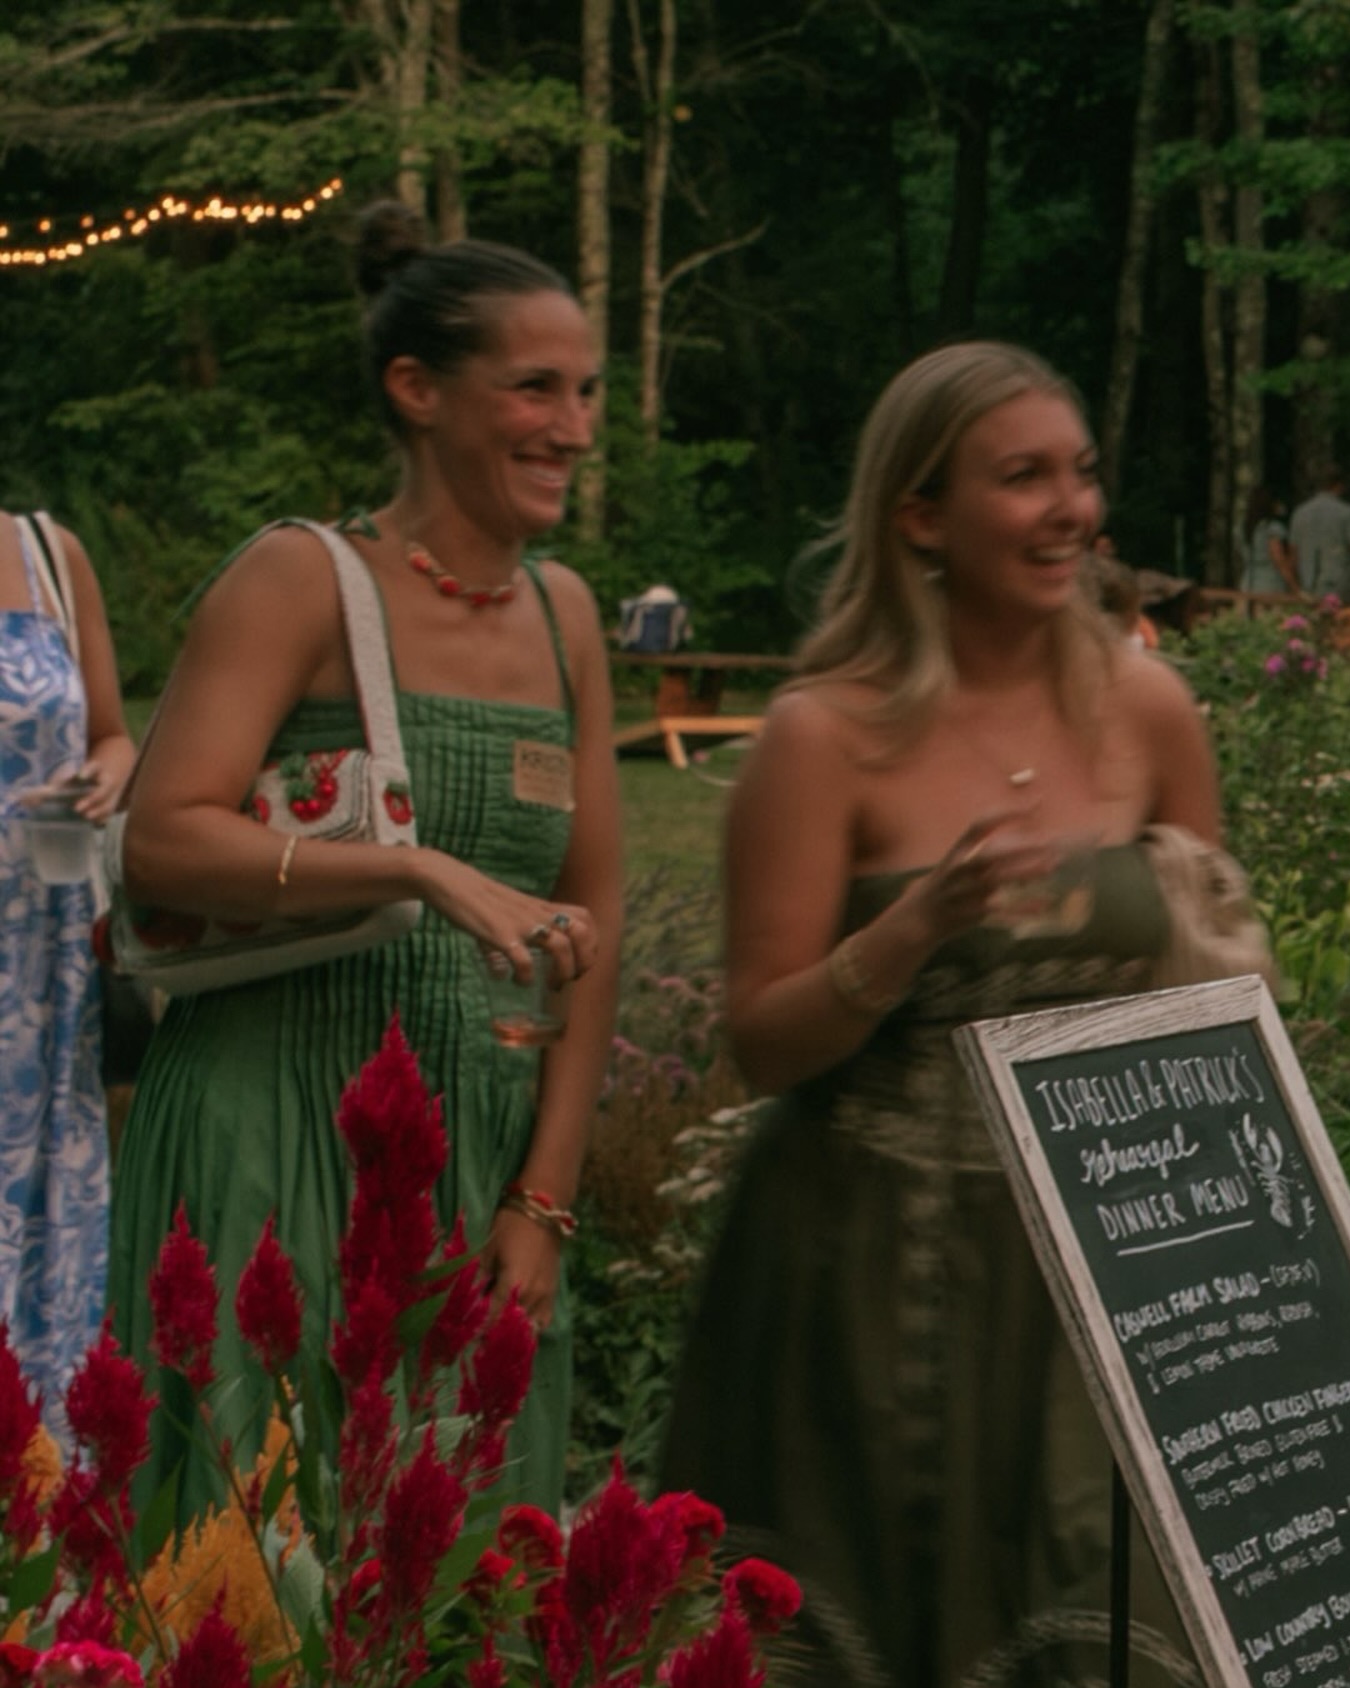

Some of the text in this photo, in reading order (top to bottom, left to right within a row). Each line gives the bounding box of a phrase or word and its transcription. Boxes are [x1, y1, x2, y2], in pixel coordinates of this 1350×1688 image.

[1035, 1046, 1265, 1132] ISABELLA & PATRICK'S
[1097, 1175, 1249, 1241] DINNER MENU
[1169, 1283, 1213, 1318] FARM
[1212, 1271, 1261, 1304] SALAD
[1162, 1418, 1223, 1465] SOUTHERN
[1220, 1404, 1262, 1436] FRIED
[1262, 1390, 1315, 1425] CHICKEN
[1211, 1535, 1263, 1580] SKILLET
[1264, 1505, 1336, 1553] CORNBREAD
[1244, 1630, 1275, 1663] LOW
[1275, 1603, 1332, 1647] COUNTRY
